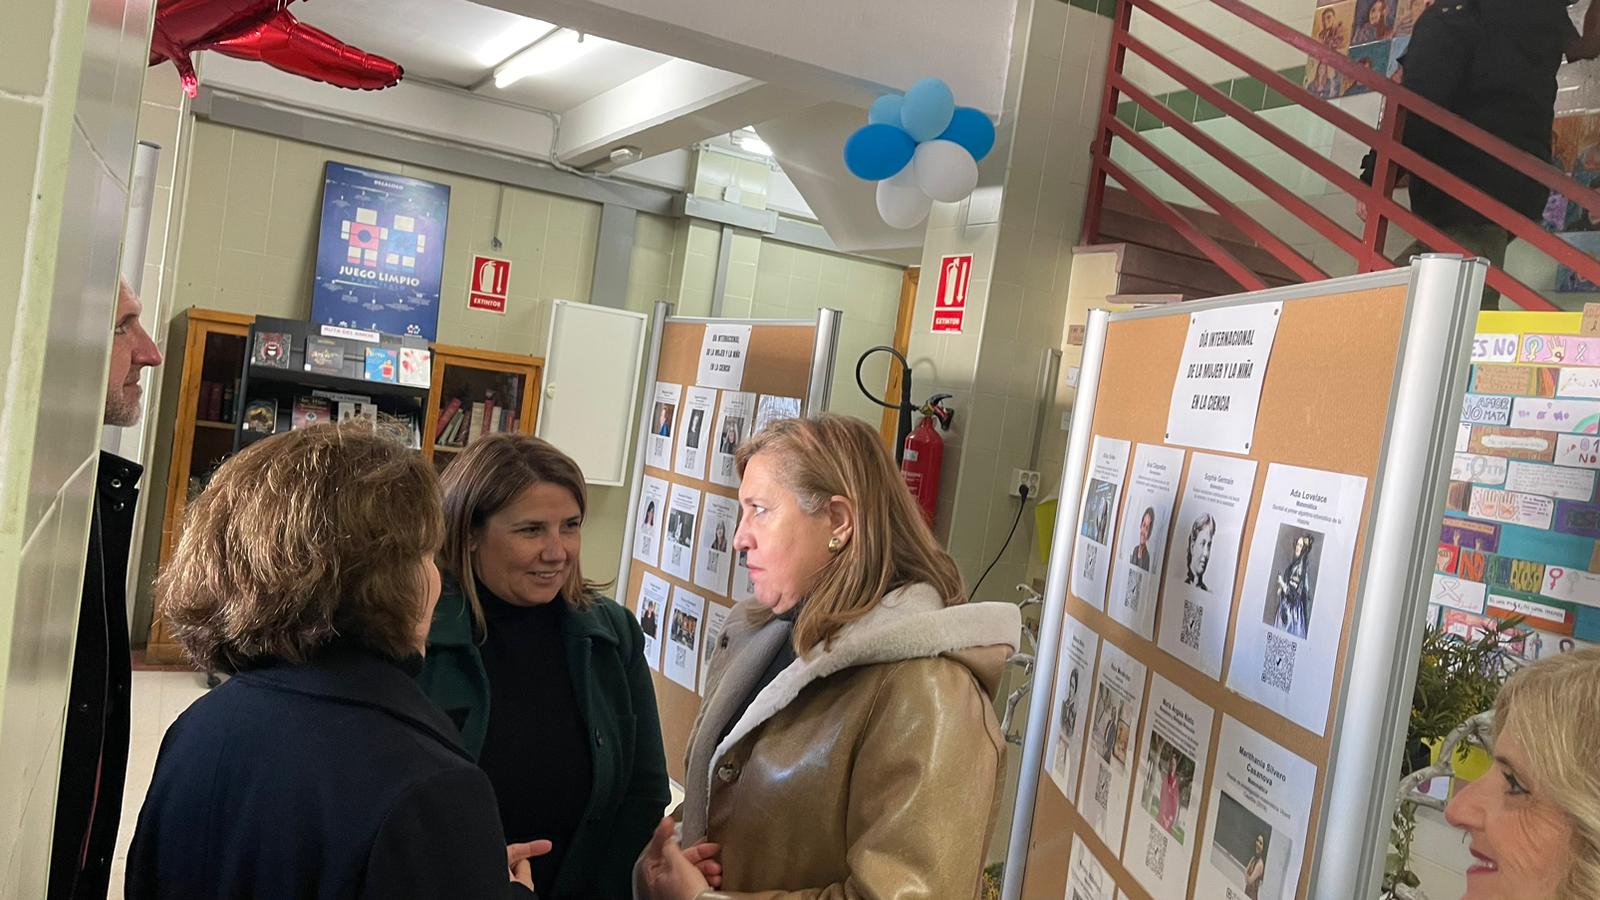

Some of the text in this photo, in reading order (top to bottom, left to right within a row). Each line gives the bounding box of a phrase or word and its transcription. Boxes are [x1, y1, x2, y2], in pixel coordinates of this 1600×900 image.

[339, 265, 376, 279] JUEGO
[378, 272, 420, 287] LIMPIO
[473, 297, 501, 308] EXTINTOR
[1208, 329, 1255, 347] INTERNACIONAL
[1493, 337, 1516, 356] NO
[1187, 359, 1254, 379] DE LA MUJER Y LA NIÑA
[1191, 394, 1231, 412] EN LA CIENCIA
[1482, 410, 1507, 421] MATA
[1289, 488, 1327, 504] Ada Lovelace
[1460, 549, 1485, 582] NO
